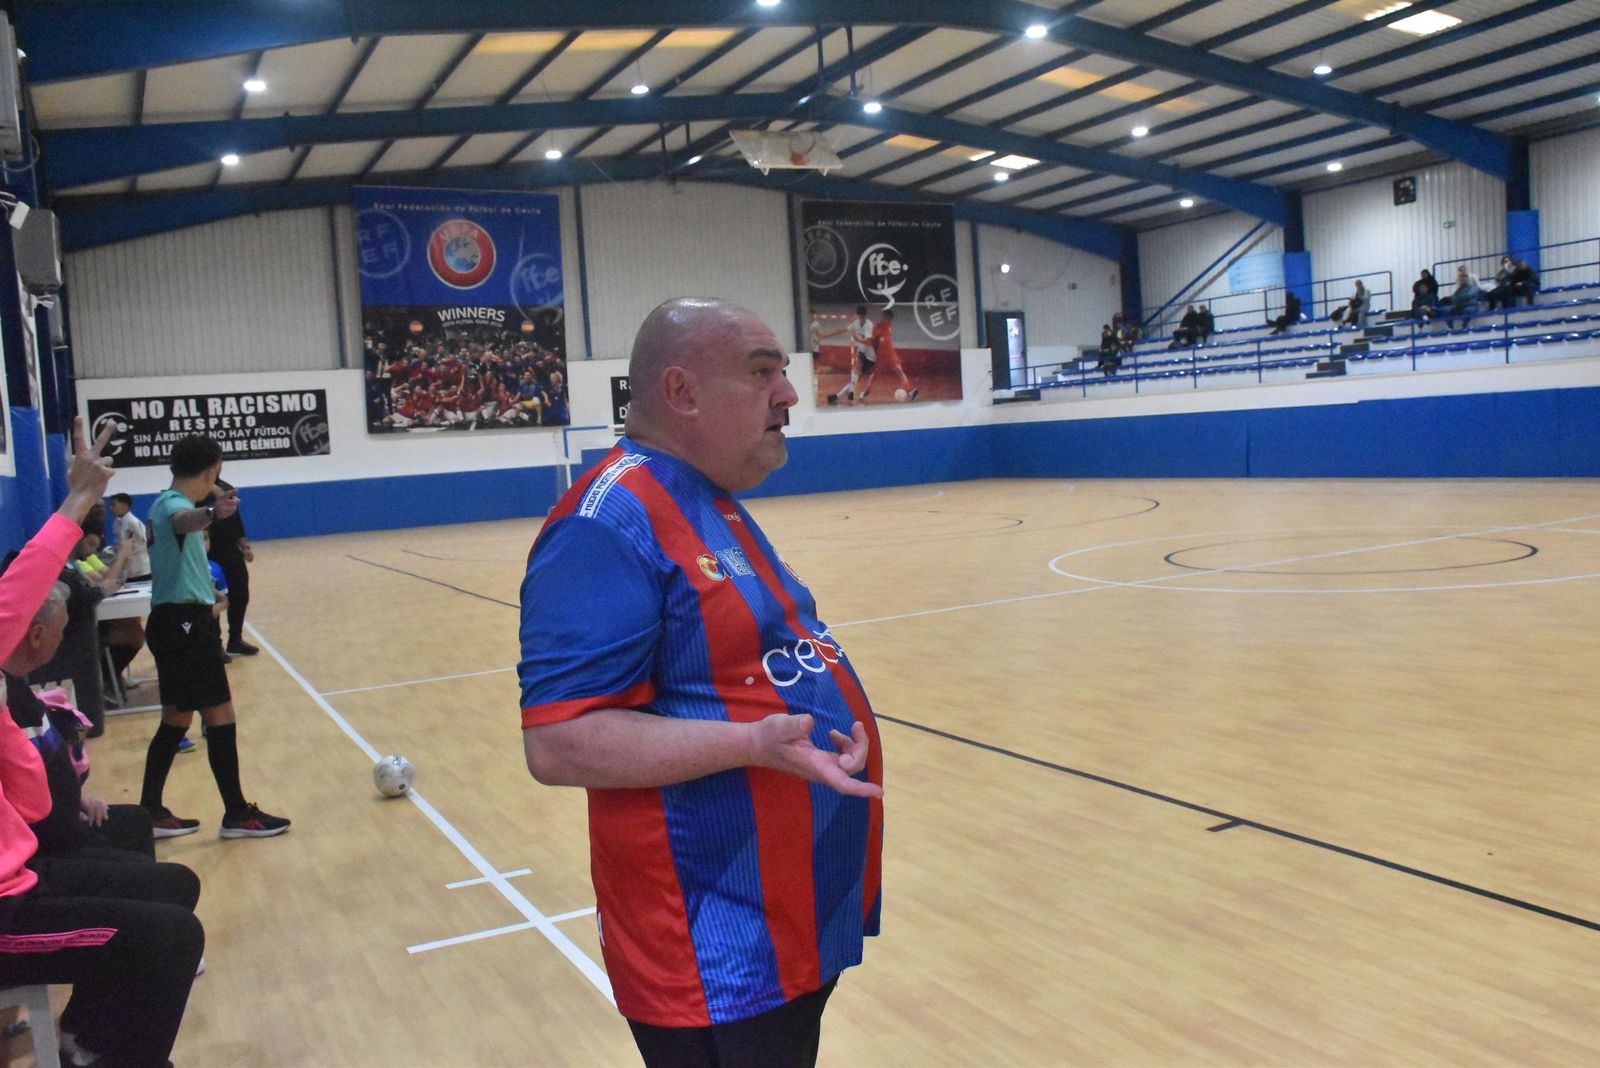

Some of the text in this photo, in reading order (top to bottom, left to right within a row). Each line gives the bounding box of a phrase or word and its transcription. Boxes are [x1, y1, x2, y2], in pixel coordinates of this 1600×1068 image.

[437, 306, 506, 322] WINNERS
[131, 392, 317, 420] NO AL RACISMO
[169, 415, 257, 431] RESPETO
[133, 433, 151, 444] SIN
[208, 430, 227, 440] NO
[229, 428, 252, 439] HAY
[254, 425, 292, 437] FÚTBOL
[135, 445, 151, 458] NO
[152, 445, 161, 456] A
[235, 440, 249, 451] DE
[250, 437, 291, 450] GÉNERO
